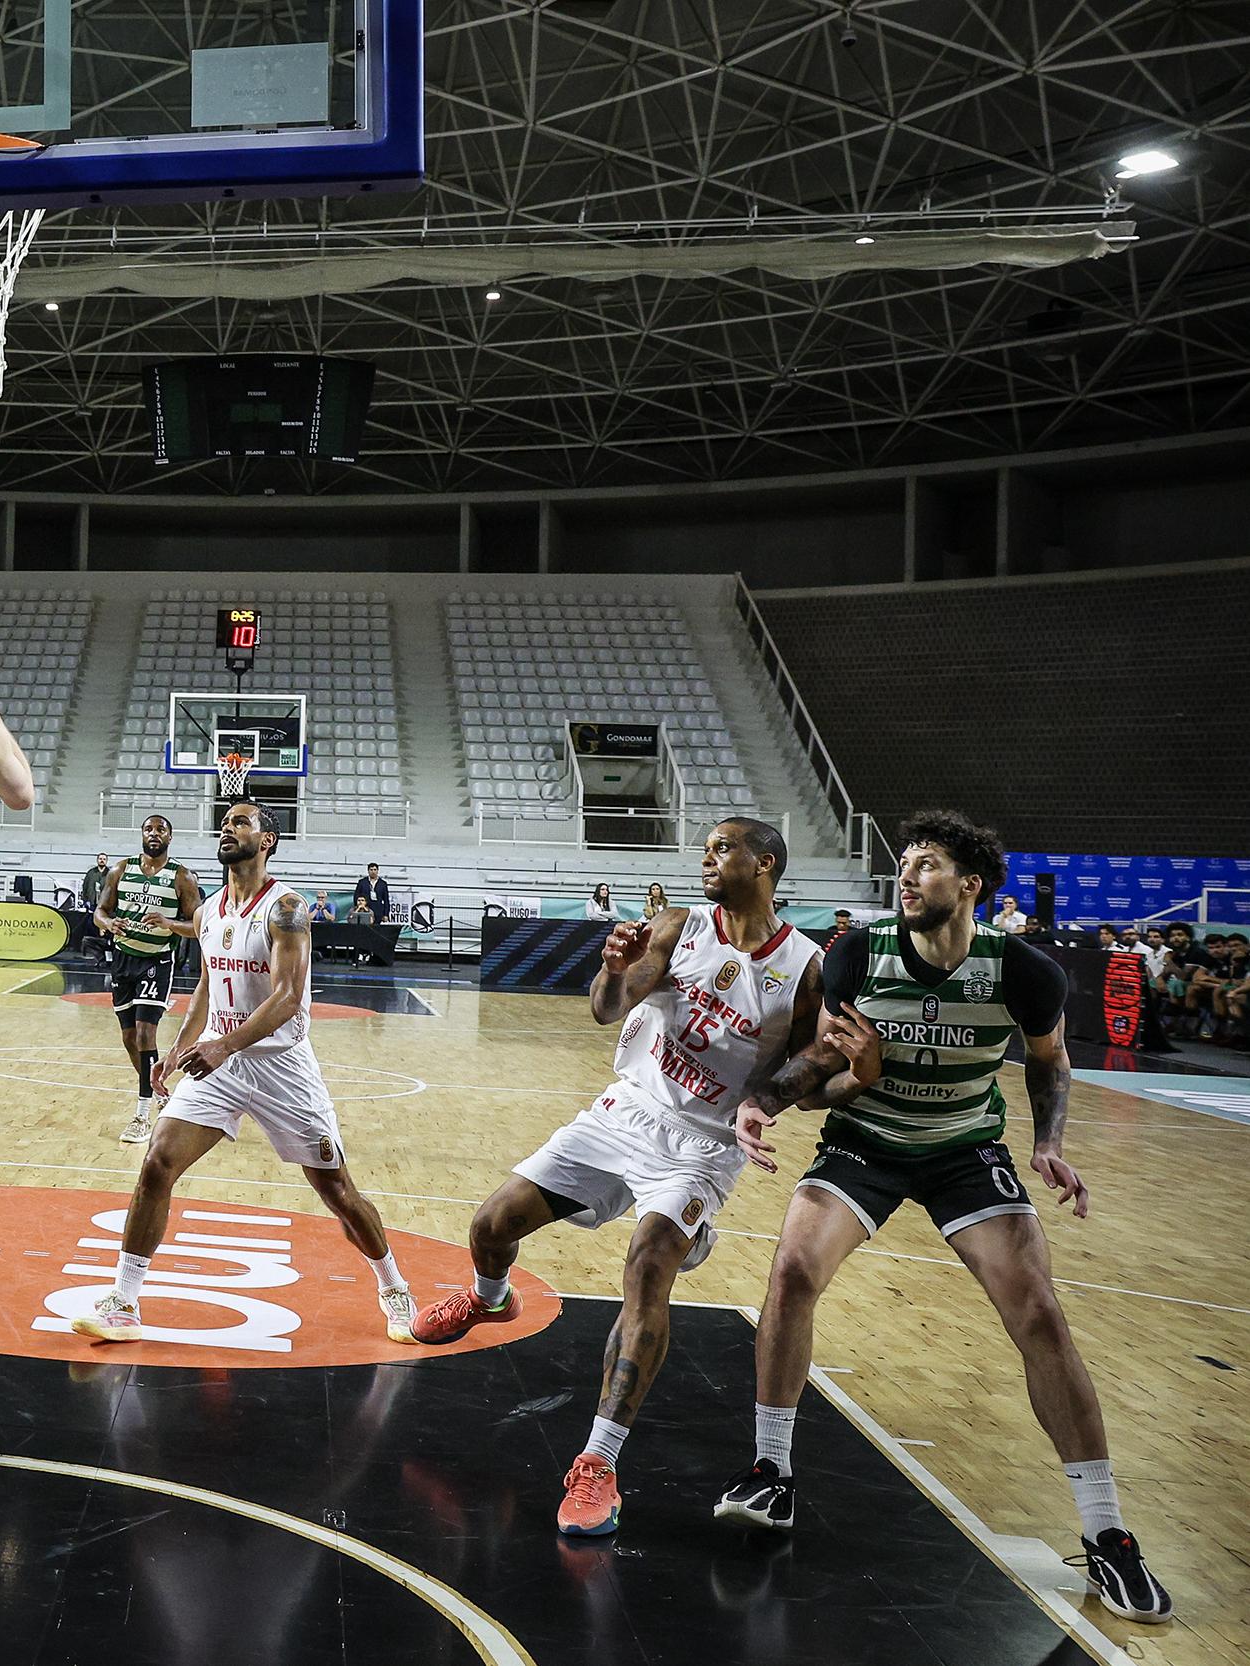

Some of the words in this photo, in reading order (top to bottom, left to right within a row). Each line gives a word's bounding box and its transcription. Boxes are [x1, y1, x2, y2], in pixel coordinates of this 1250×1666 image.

[233, 627, 255, 646] 10
[607, 733, 653, 742] GONDOMAR
[125, 892, 162, 906] SPORTING
[510, 908, 529, 918] HUGO
[210, 956, 270, 974] BENFICA
[139, 981, 159, 999] 24
[222, 977, 234, 1007] 1
[688, 984, 762, 1037] BENFICA
[678, 1008, 719, 1053] 15
[876, 1021, 975, 1047] SPORTING
[662, 1035, 718, 1079] conservas
[883, 1079, 959, 1100] Buildity.
[991, 1165, 1020, 1198] 0
